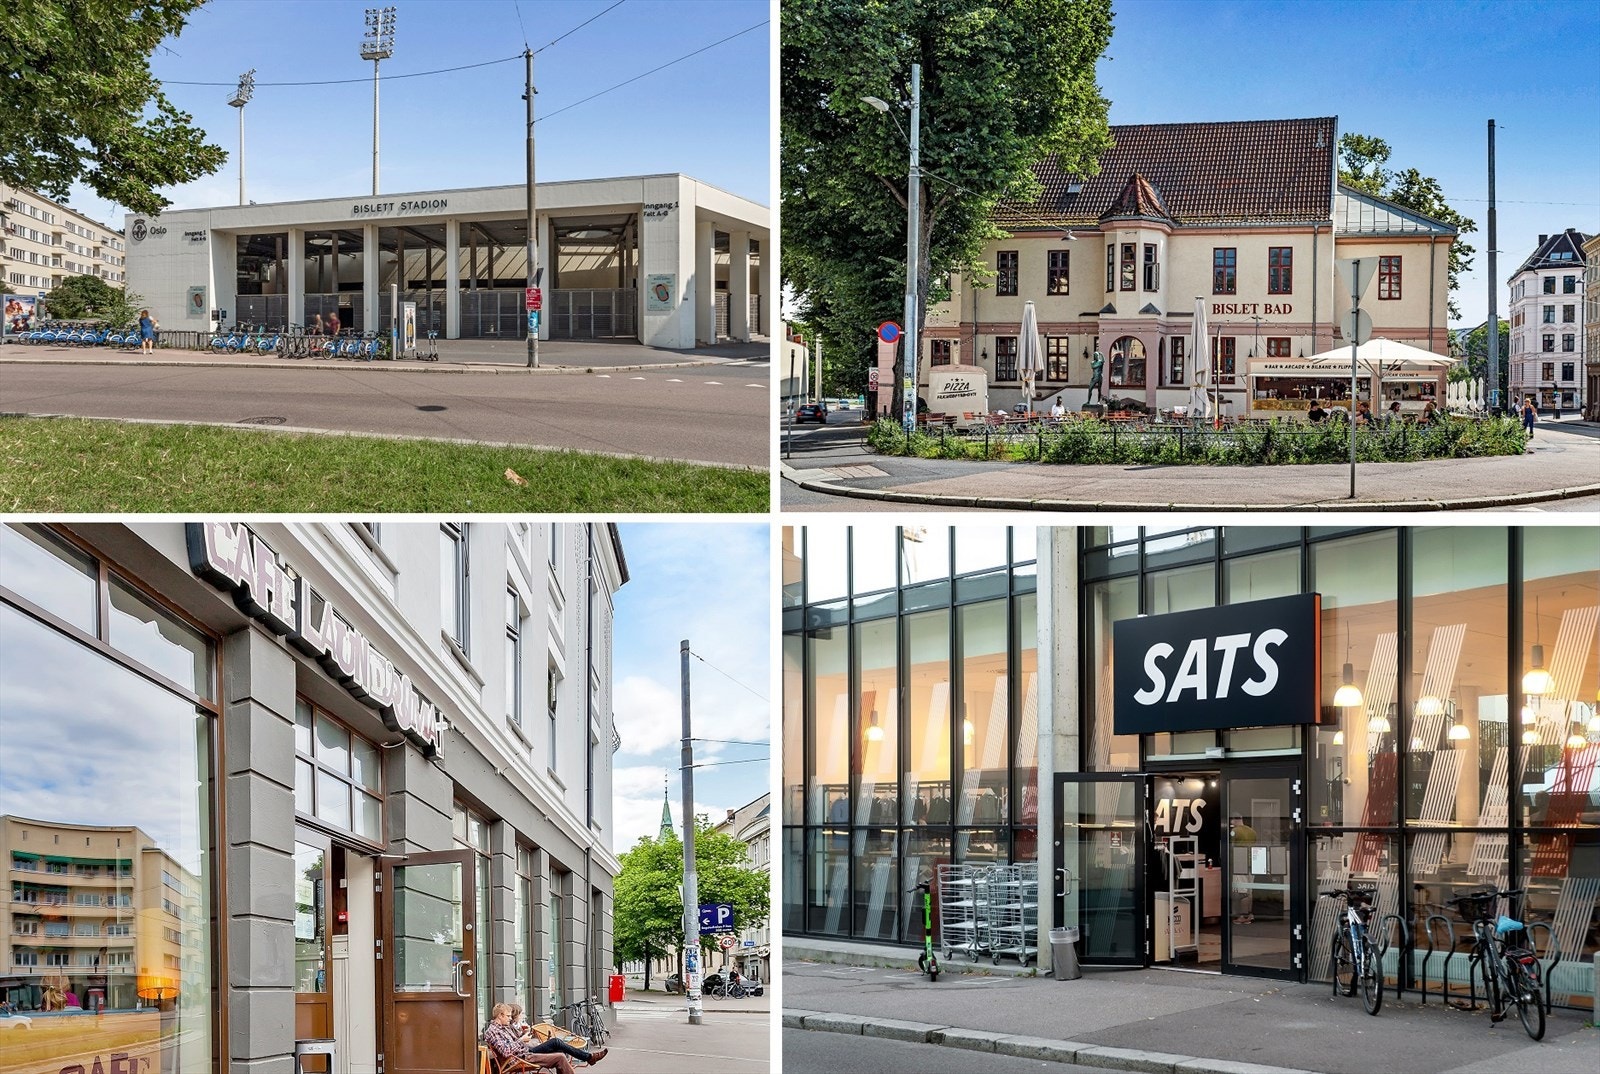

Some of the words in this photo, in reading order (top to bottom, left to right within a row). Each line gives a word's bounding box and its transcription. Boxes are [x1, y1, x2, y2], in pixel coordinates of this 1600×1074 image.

[353, 202, 395, 214] BISLETT
[400, 199, 448, 211] STADION
[643, 202, 673, 210] Inngang
[150, 226, 167, 235] Oslo
[1212, 303, 1260, 315] BISLET
[1263, 303, 1293, 315] BAD
[943, 382, 970, 391] PIZZA
[1133, 628, 1289, 706] SATS
[1154, 798, 1207, 833] ATS
[717, 907, 730, 924] P
